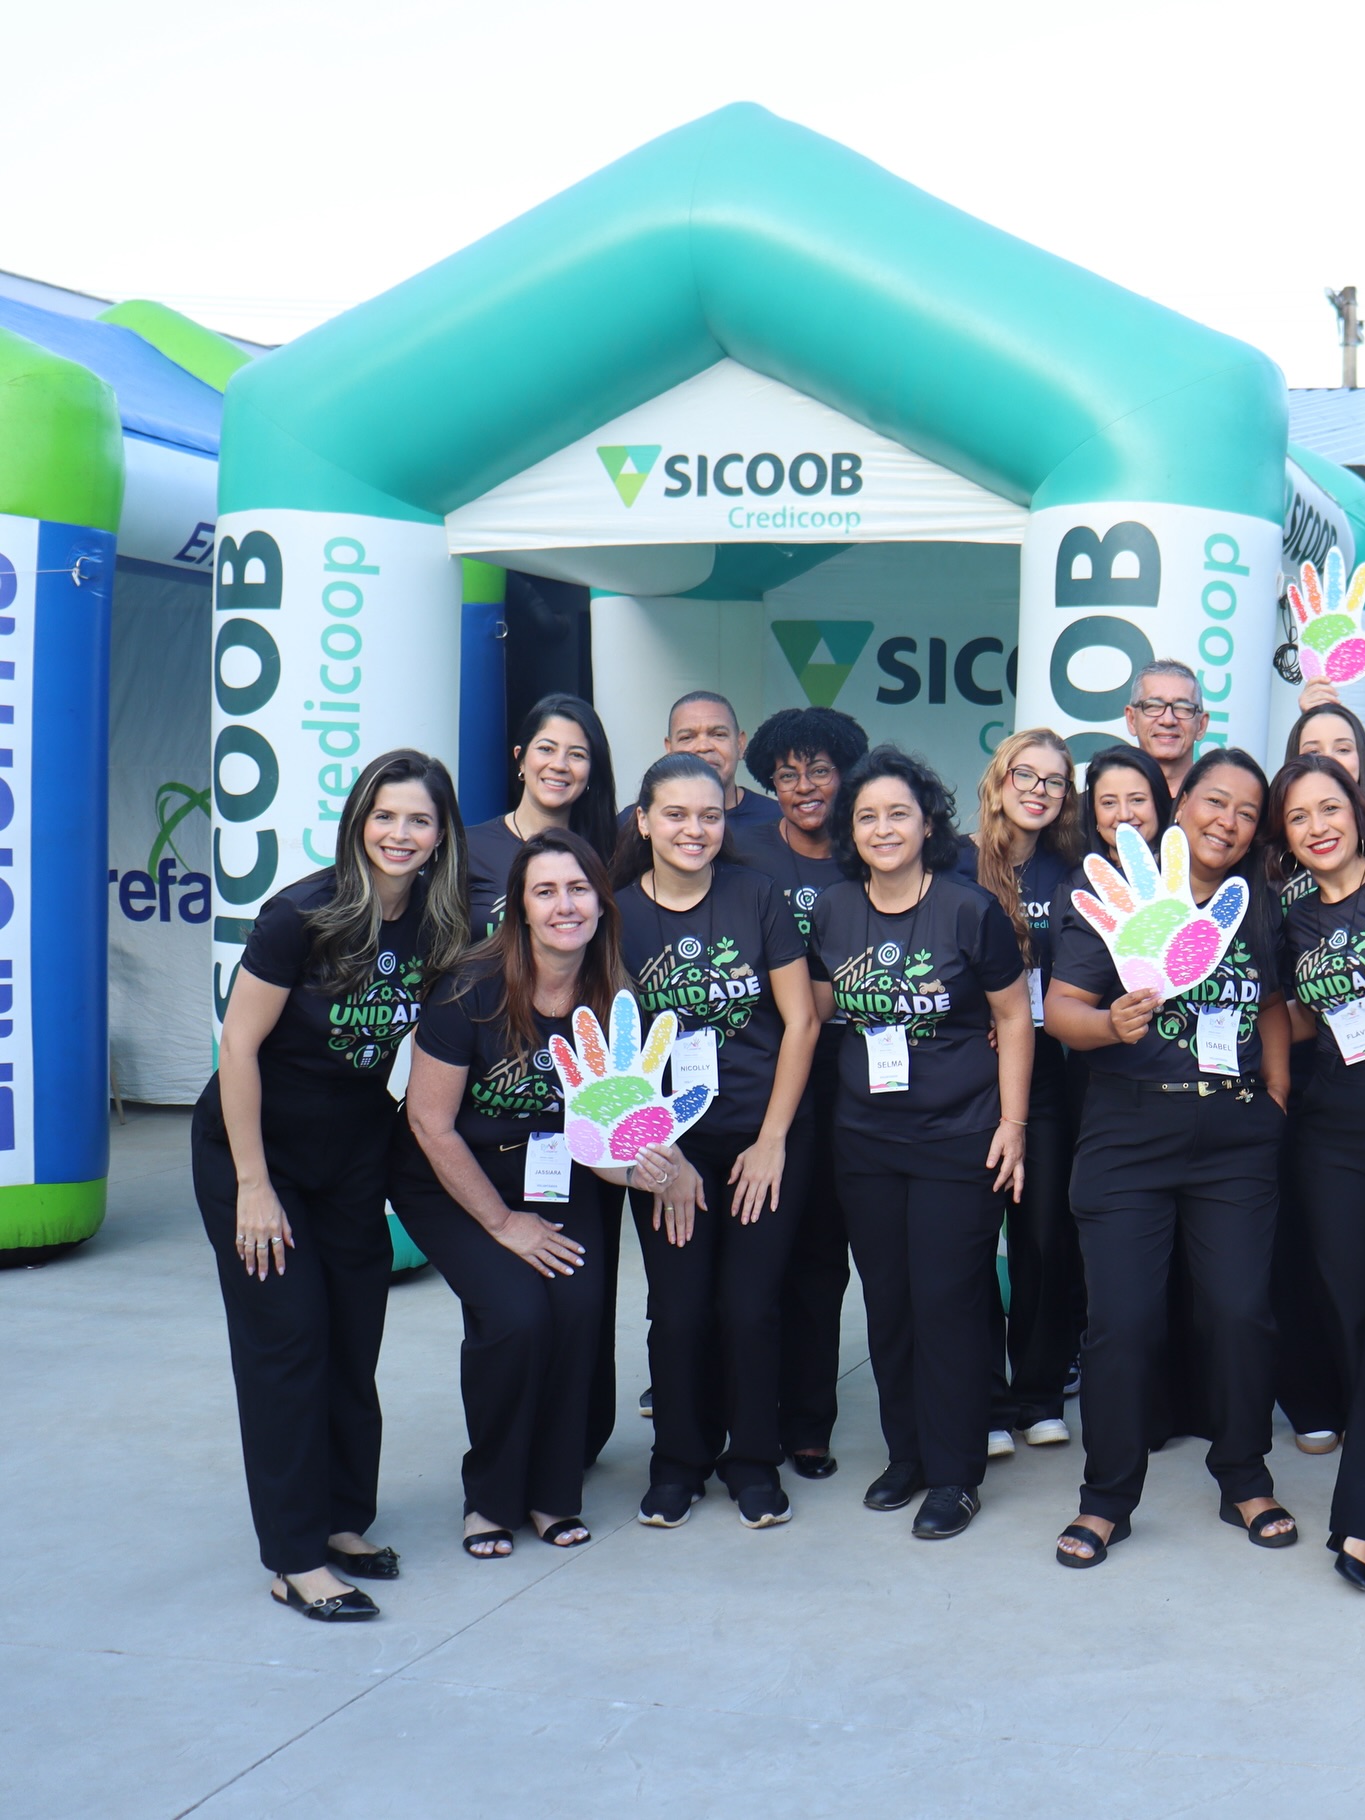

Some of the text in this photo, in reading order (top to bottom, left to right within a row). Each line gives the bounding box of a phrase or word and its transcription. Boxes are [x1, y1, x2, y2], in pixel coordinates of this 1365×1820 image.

[664, 453, 864, 498] SICOOB
[728, 505, 861, 534] Credicoop
[640, 976, 761, 1011] UNIDADE
[834, 993, 951, 1014] UNIDADE
[1205, 1041, 1232, 1051] ISABEL
[680, 1064, 711, 1072] NICOLLY
[877, 1060, 903, 1069] SELMA
